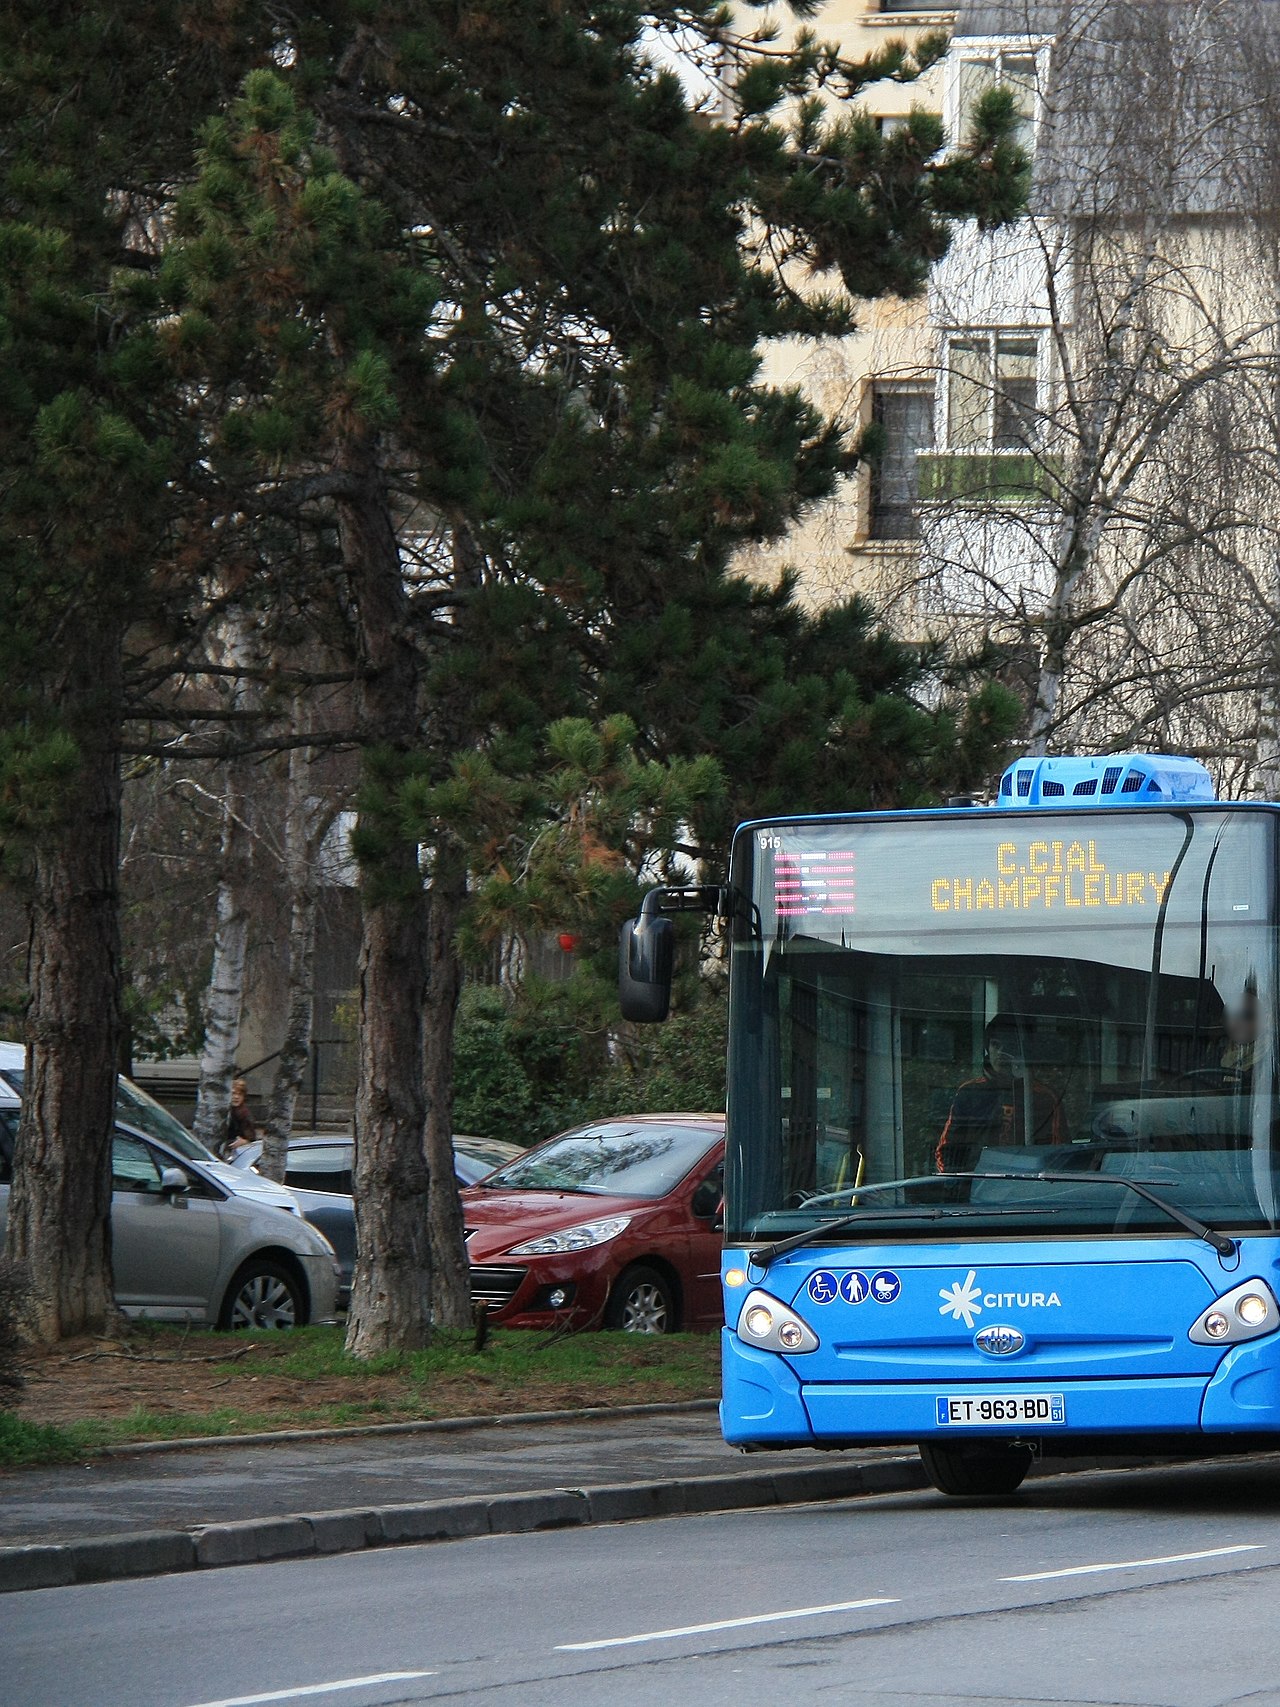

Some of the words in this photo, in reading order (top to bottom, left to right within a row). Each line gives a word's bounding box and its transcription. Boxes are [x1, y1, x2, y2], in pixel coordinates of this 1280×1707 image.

[760, 836, 781, 850] 915
[997, 839, 1106, 874] C.CIAL
[930, 871, 1170, 911] CHAMPFLEURY
[983, 1292, 1062, 1308] CITURA
[949, 1398, 1049, 1421] ET-963-BD
[1052, 1409, 1062, 1420] 51
